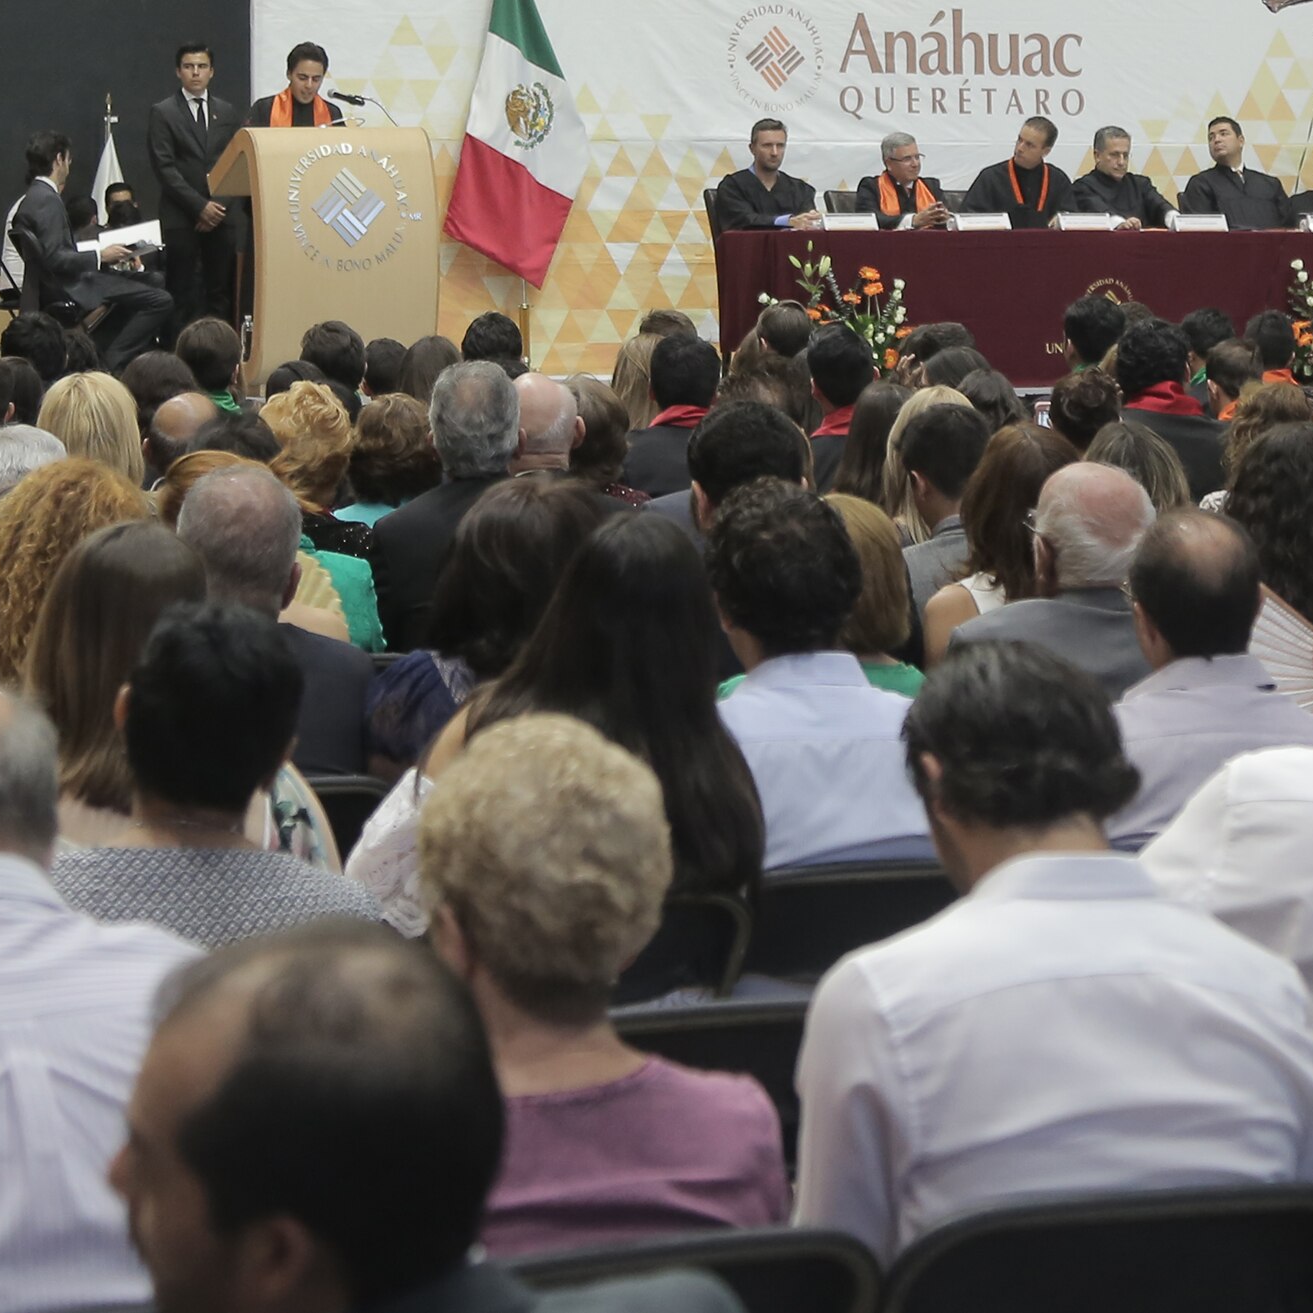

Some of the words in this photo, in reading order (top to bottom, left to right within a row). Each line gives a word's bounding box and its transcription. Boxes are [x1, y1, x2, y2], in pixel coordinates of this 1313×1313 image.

[727, 4, 784, 63] UNIVERSIDAD
[787, 7, 824, 64] ANÁHUAC
[839, 8, 1083, 77] Anáhuac
[839, 79, 1085, 120] QUERÉTARO
[288, 143, 353, 215] UNIVERSIDAD
